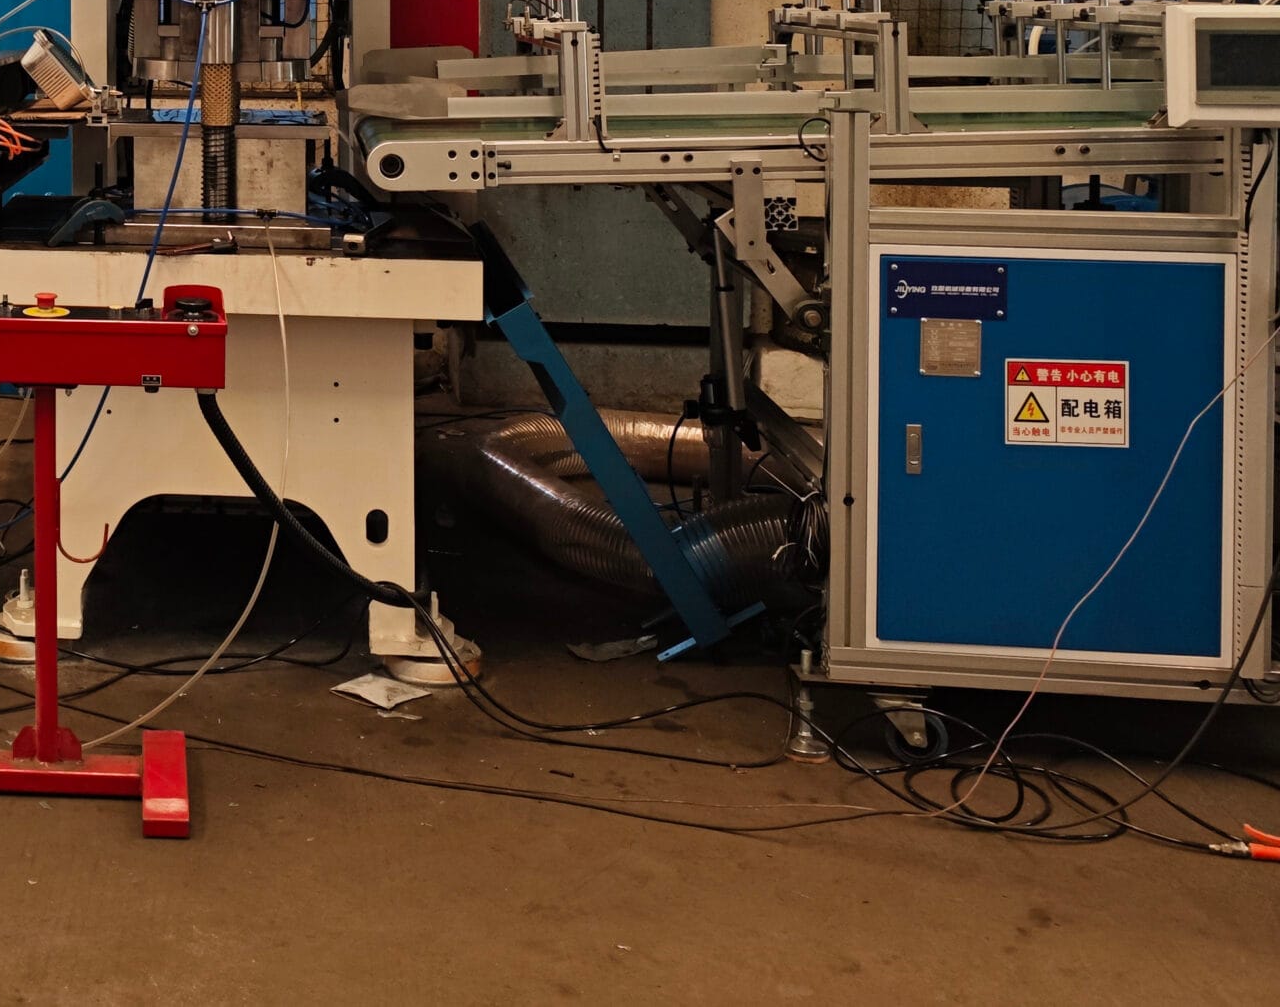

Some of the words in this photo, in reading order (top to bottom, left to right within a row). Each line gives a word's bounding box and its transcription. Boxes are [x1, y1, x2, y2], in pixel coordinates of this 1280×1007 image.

[1037, 369, 1062, 382] 警告
[1066, 369, 1120, 383] 小心有电
[1061, 399, 1122, 419] 配电箱
[1012, 427, 1050, 436] 当心触电
